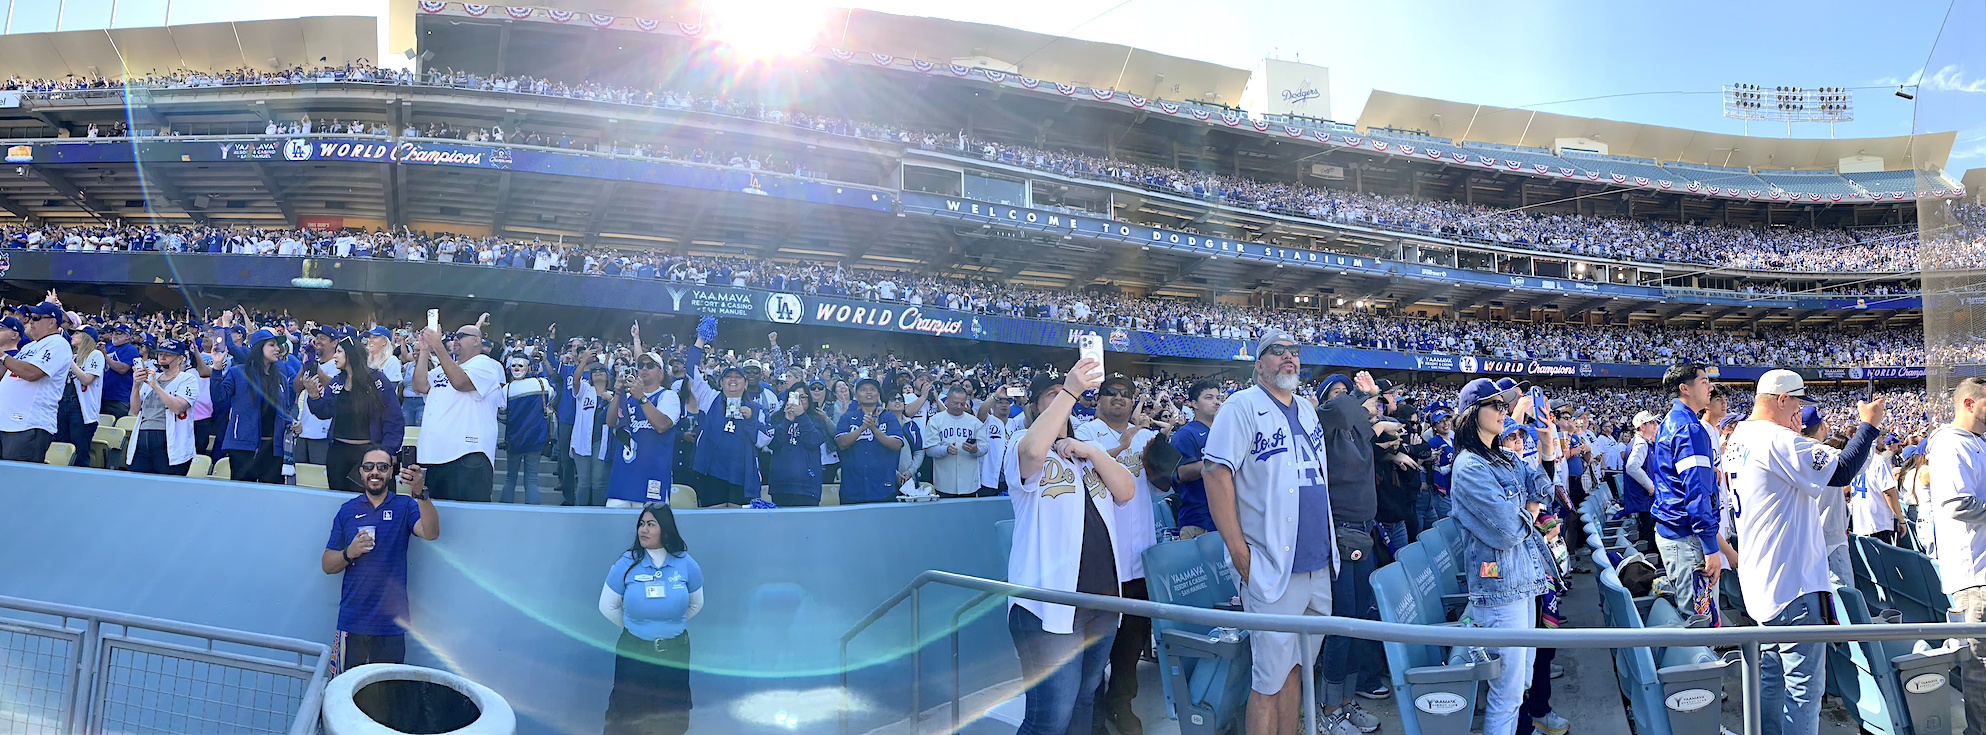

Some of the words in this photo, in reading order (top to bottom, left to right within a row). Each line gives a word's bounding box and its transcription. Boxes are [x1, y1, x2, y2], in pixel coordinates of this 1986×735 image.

[1282, 88, 1320, 103] Dodgers
[320, 143, 387, 159] WORLD
[390, 142, 482, 165] Champions
[946, 200, 1077, 229] WELCOME
[1103, 223, 1130, 236] TO
[1153, 231, 1244, 252] DODGER
[1264, 247, 1363, 268] STADIUM
[692, 290, 752, 304] YAAMAVA'
[719, 308, 747, 316] MANUEL
[727, 302, 753, 310] CASINO
[776, 296, 793, 320] LA
[816, 302, 894, 326] WORLD
[898, 306, 963, 336] Champio
[1484, 361, 1524, 373] WORLD
[1528, 360, 1575, 376] Champions
[1867, 368, 1897, 378] WORLD
[1170, 562, 1206, 584] YAAMAVA'
